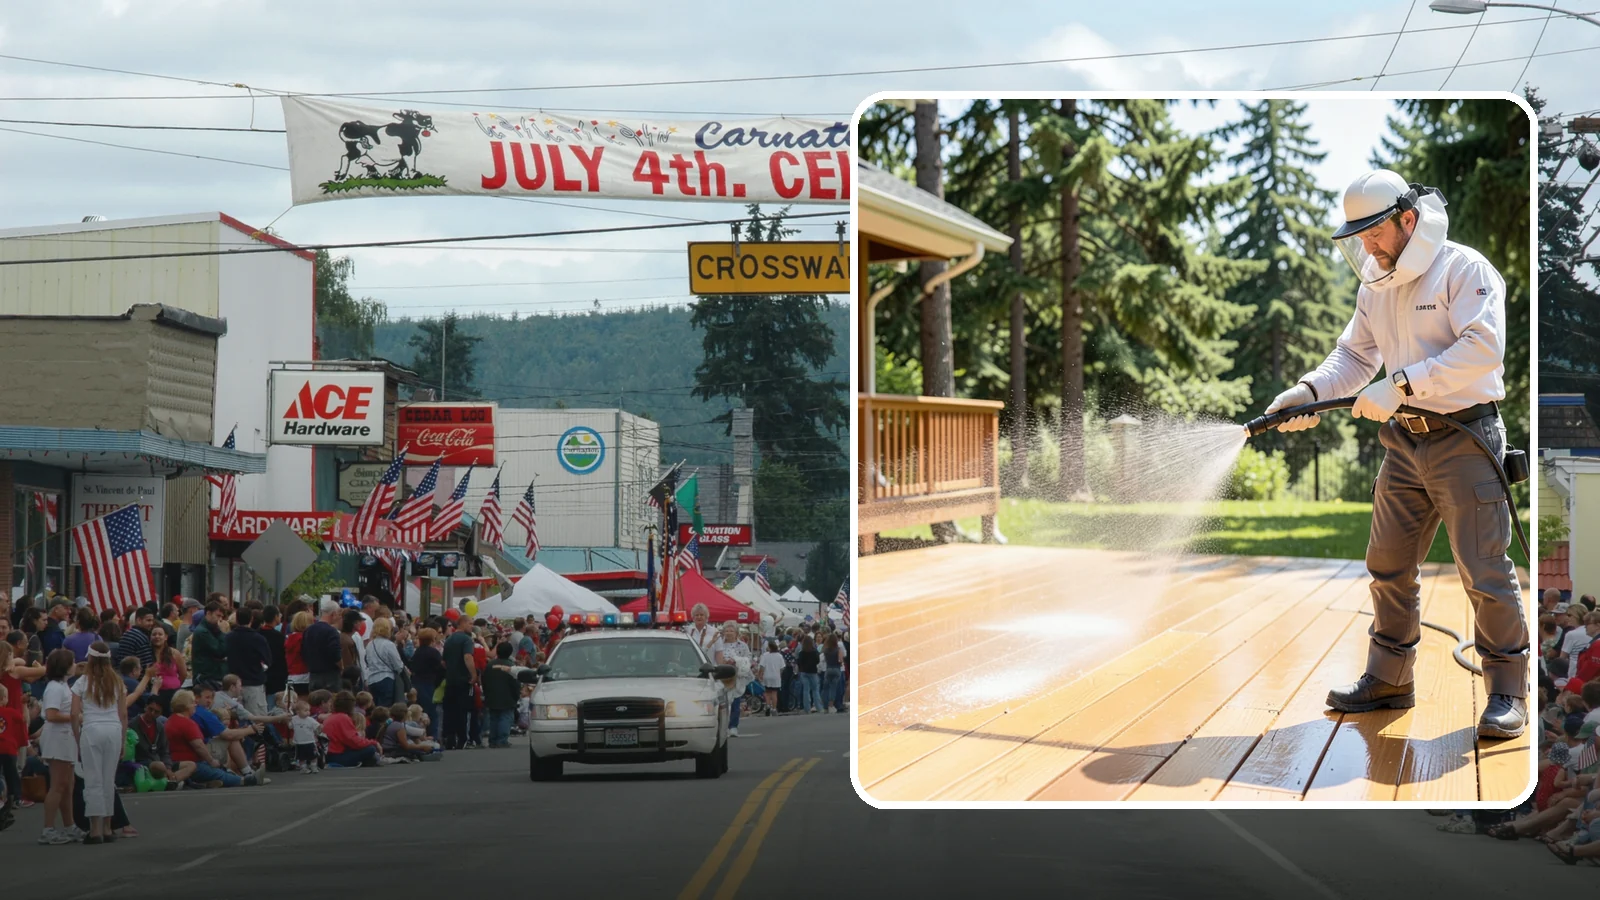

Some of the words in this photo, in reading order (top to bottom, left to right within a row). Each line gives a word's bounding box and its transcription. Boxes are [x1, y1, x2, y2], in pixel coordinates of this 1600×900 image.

[481, 141, 605, 192] JULY
[632, 150, 746, 198] 4th.
[697, 254, 850, 280] CROSSWA
[282, 380, 374, 419] ACE
[405, 409, 453, 422] CEDAR
[461, 409, 485, 422] LOG
[283, 421, 371, 436] Hardware
[416, 428, 477, 447] Coca-Cola
[95, 484, 124, 495] Vincent
[126, 486, 136, 495] de
[138, 485, 155, 495] Paul
[688, 526, 741, 535] CRNATION
[699, 535, 730, 543] GLASS
